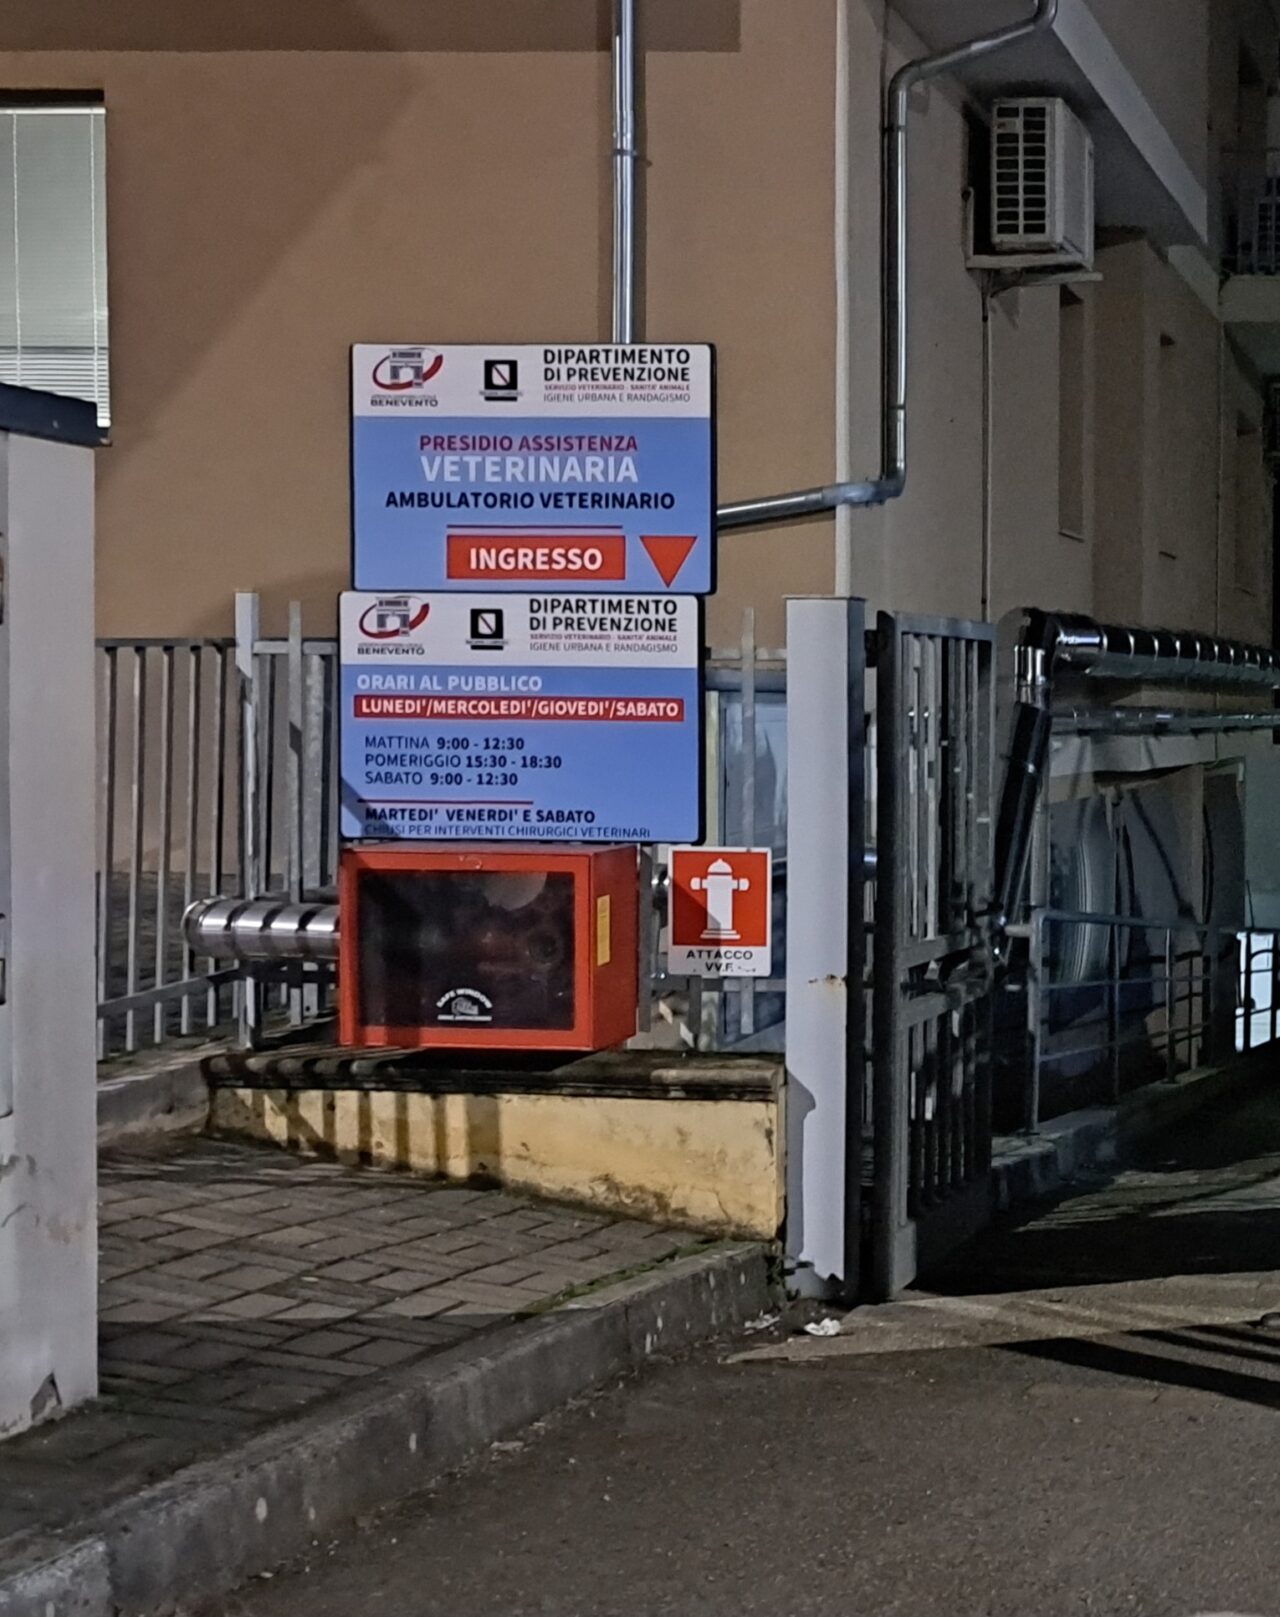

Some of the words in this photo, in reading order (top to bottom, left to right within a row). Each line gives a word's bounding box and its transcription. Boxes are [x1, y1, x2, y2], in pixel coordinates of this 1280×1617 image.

[543, 348, 690, 365] DIPARTIMENTO
[543, 367, 561, 382] DI
[566, 367, 690, 382] PREVENZIONE
[370, 399, 438, 407] BENEVENTO
[543, 392, 575, 402] IGIENE
[577, 392, 616, 402] URBANA
[618, 392, 625, 402] E
[626, 392, 691, 403] RANDAGISMO
[419, 435, 513, 451] PRESIDIO
[518, 435, 638, 451] ASSISTENZA
[420, 456, 639, 483] VETERINARIA
[385, 491, 535, 509] AMBULATORIO
[539, 492, 676, 509] VETERINARIO
[469, 547, 603, 570] INGRESSO
[529, 598, 678, 615] DIPARTIMENTO
[529, 616, 546, 631] DI
[552, 616, 678, 632] PREVENZIONE
[357, 647, 425, 655] BENEVENTO
[529, 642, 560, 651] IGIENE
[563, 642, 602, 651] URBANA
[605, 642, 612, 651] E
[613, 643, 678, 653] RANDAGISMO
[357, 674, 415, 691] ORARI
[419, 675, 442, 691] AL
[447, 675, 542, 691] PUBBLICO
[365, 735, 430, 750] MATTINA
[436, 737, 470, 750] 9:00
[483, 736, 525, 750] 12:30
[365, 754, 461, 768] POMERIGGIO
[466, 754, 507, 768] 15:30
[521, 755, 562, 769] 18:30
[365, 771, 423, 786] SABATO
[430, 772, 463, 786] 9:00
[477, 773, 518, 787] 12:30
[365, 808, 438, 821] MARTEDI'
[445, 808, 518, 822] VENERDI'
[522, 809, 532, 822] E
[536, 809, 596, 823] SABATO
[408, 825, 433, 836] PER
[434, 825, 505, 836] INTERVENTI
[507, 826, 578, 837] CHIRURGICI
[580, 827, 651, 839] VETERINARI
[686, 949, 754, 961] ATTACCO
